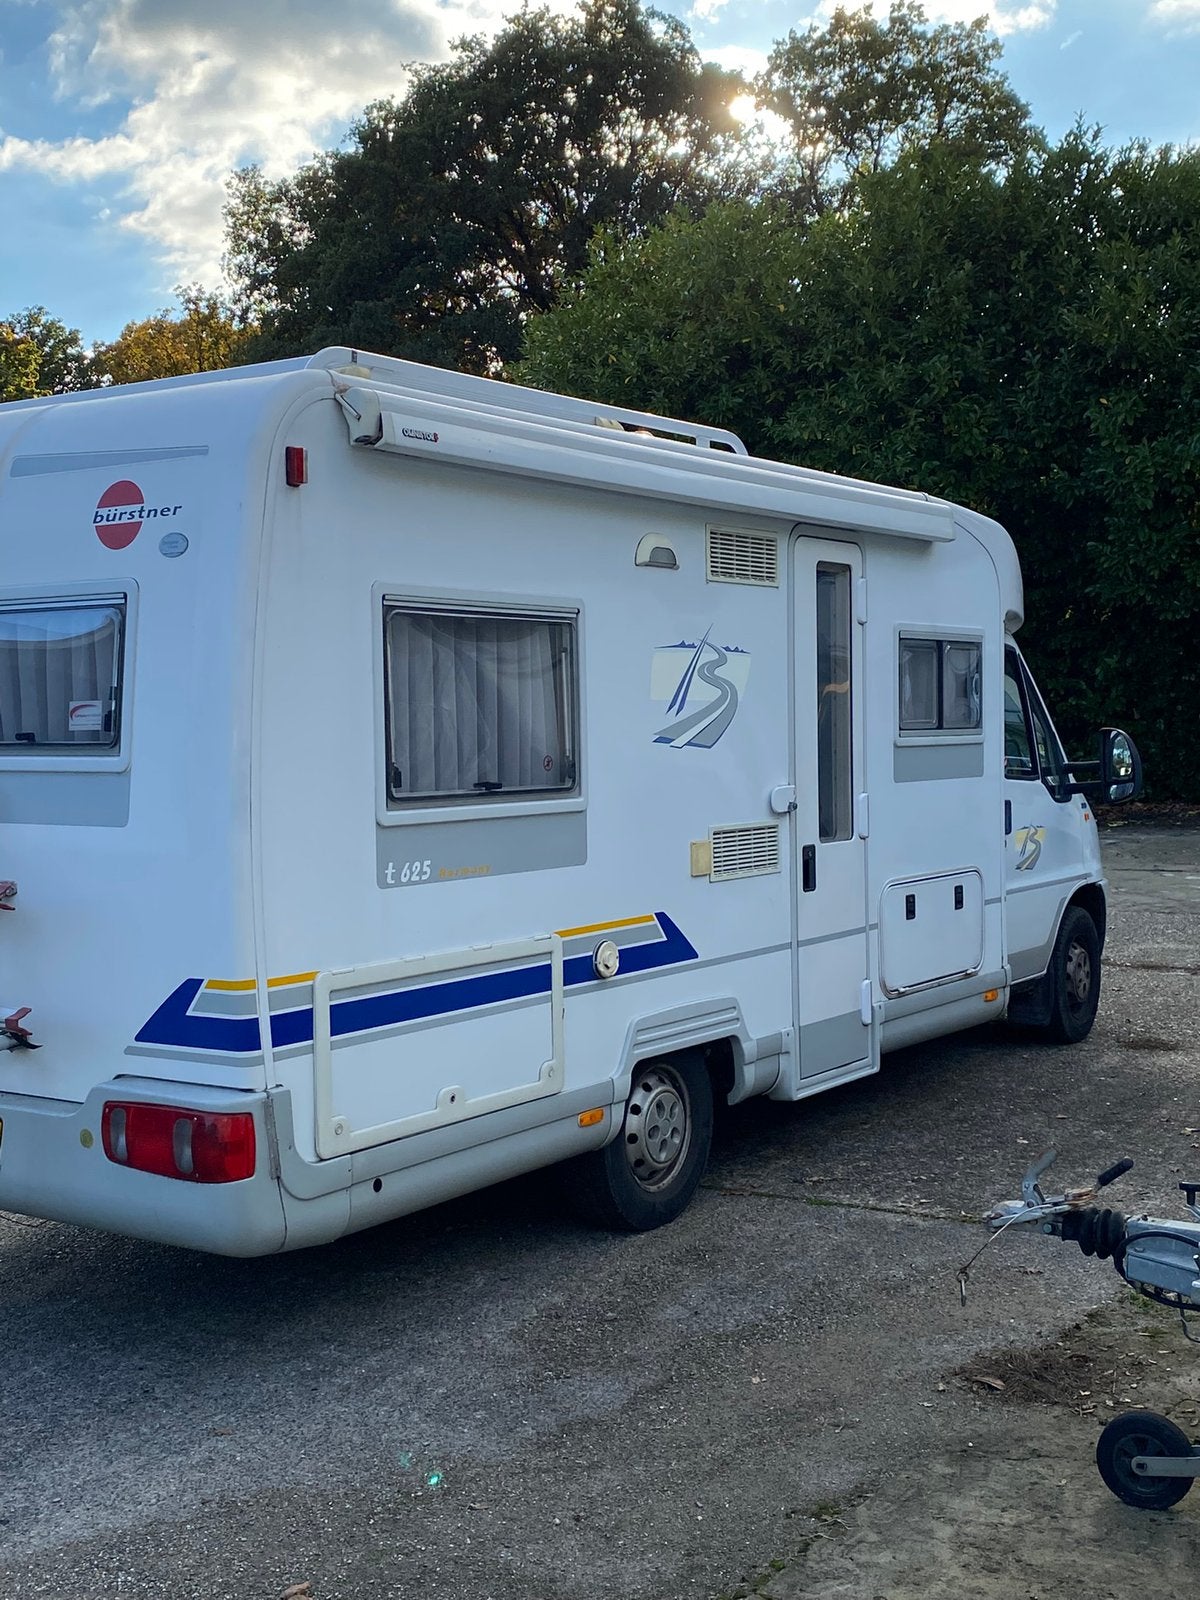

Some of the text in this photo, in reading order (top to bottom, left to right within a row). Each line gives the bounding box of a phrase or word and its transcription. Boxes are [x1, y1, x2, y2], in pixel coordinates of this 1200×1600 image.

[92, 504, 182, 525] bürstner
[384, 861, 396, 884] t
[400, 859, 431, 883] 625
